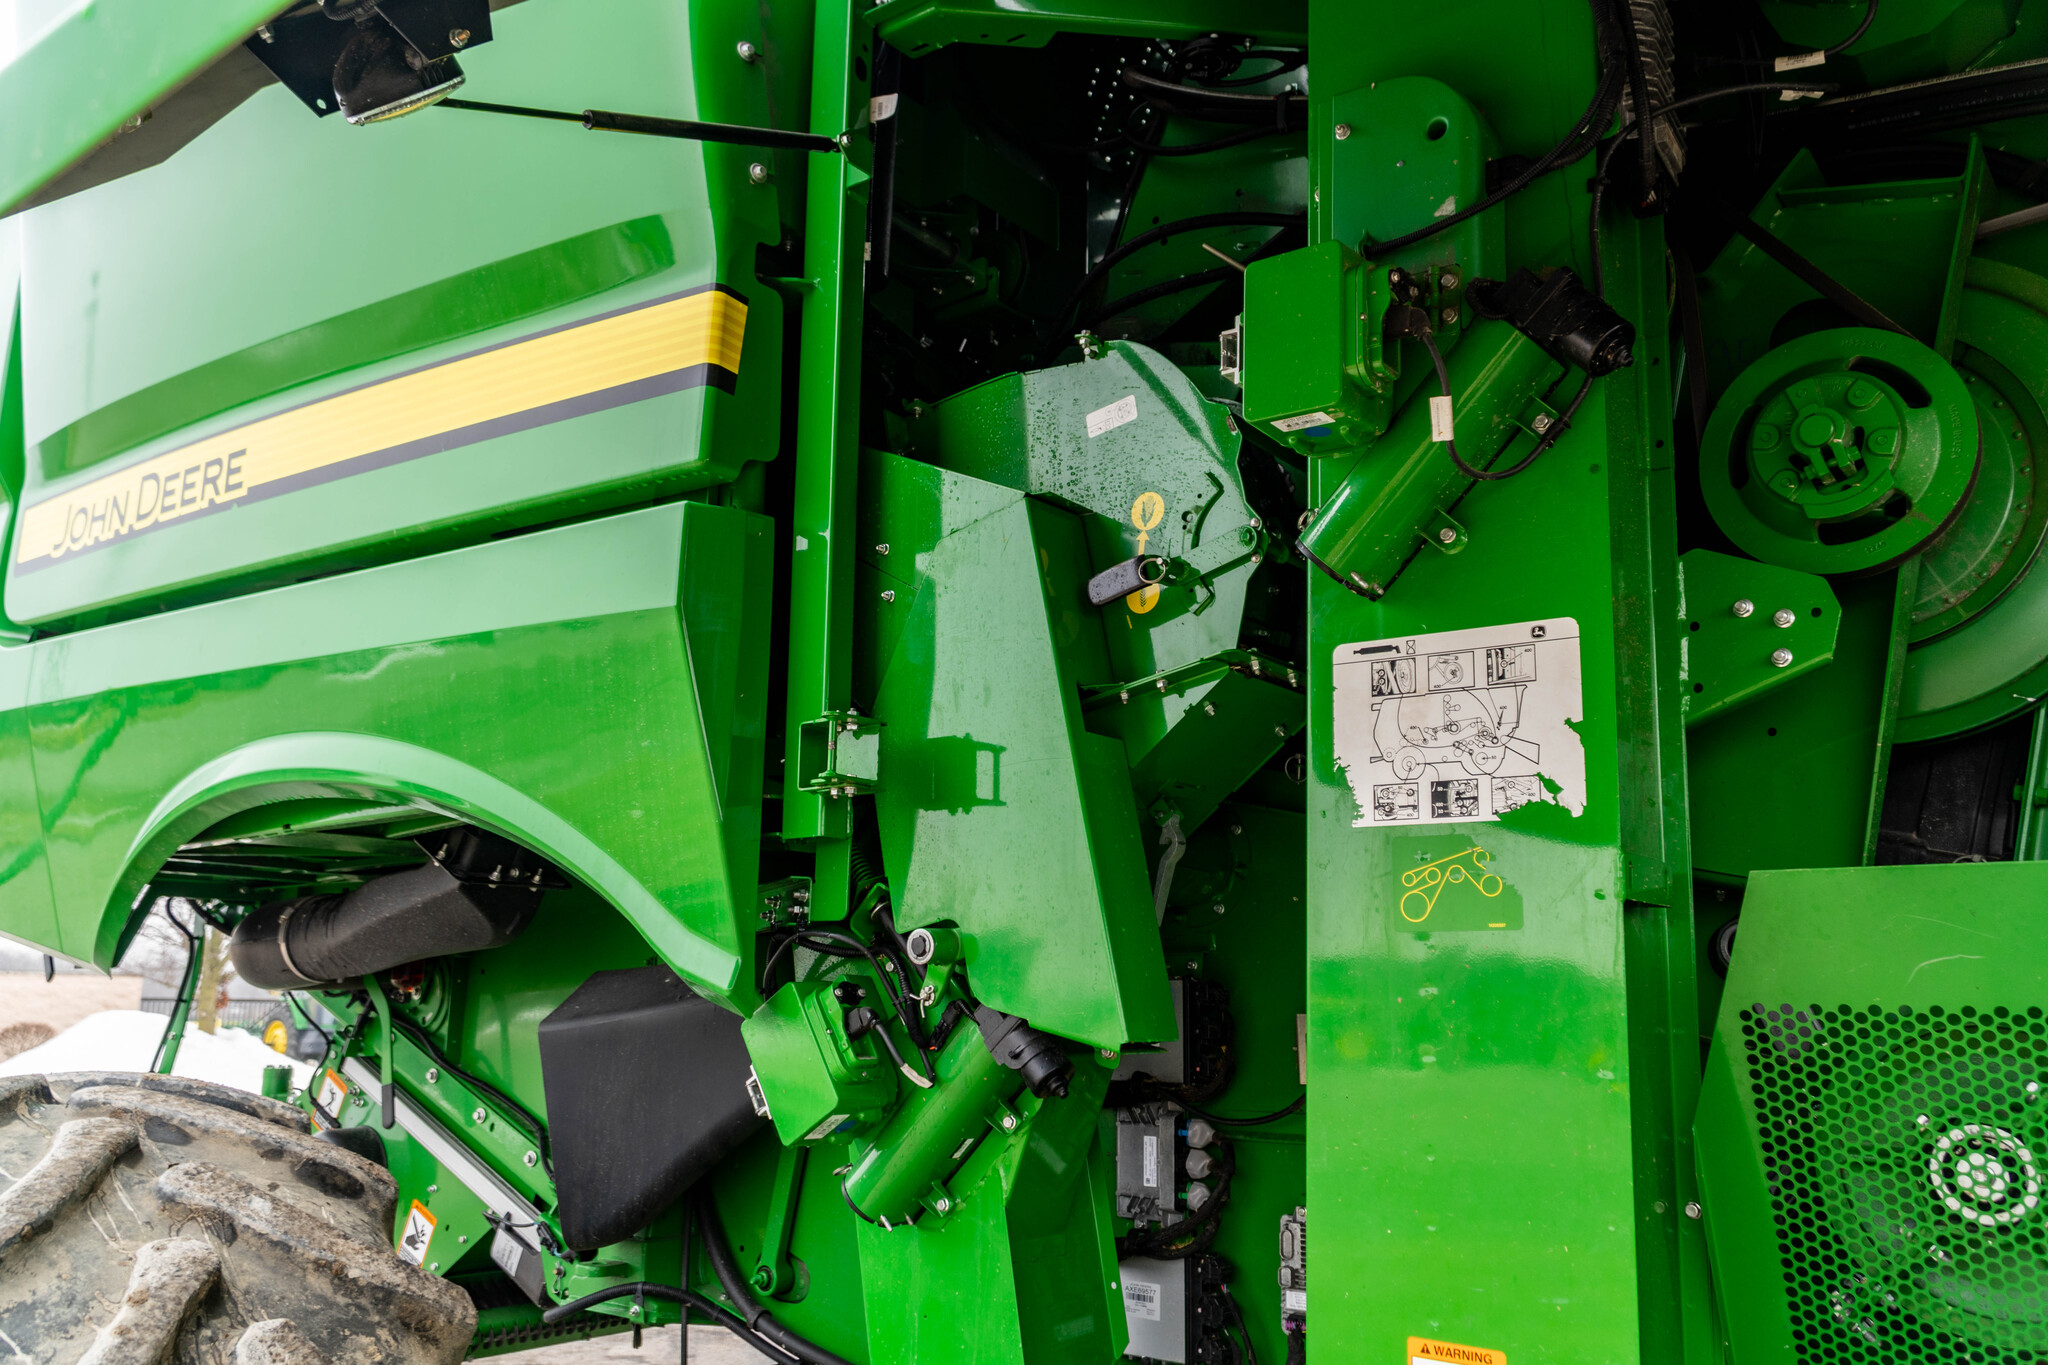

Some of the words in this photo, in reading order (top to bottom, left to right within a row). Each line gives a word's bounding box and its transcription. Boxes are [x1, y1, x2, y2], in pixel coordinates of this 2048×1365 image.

[53, 490, 130, 551] JOHN
[136, 447, 248, 525] DEERE
[1433, 1344, 1493, 1365] WARNING
